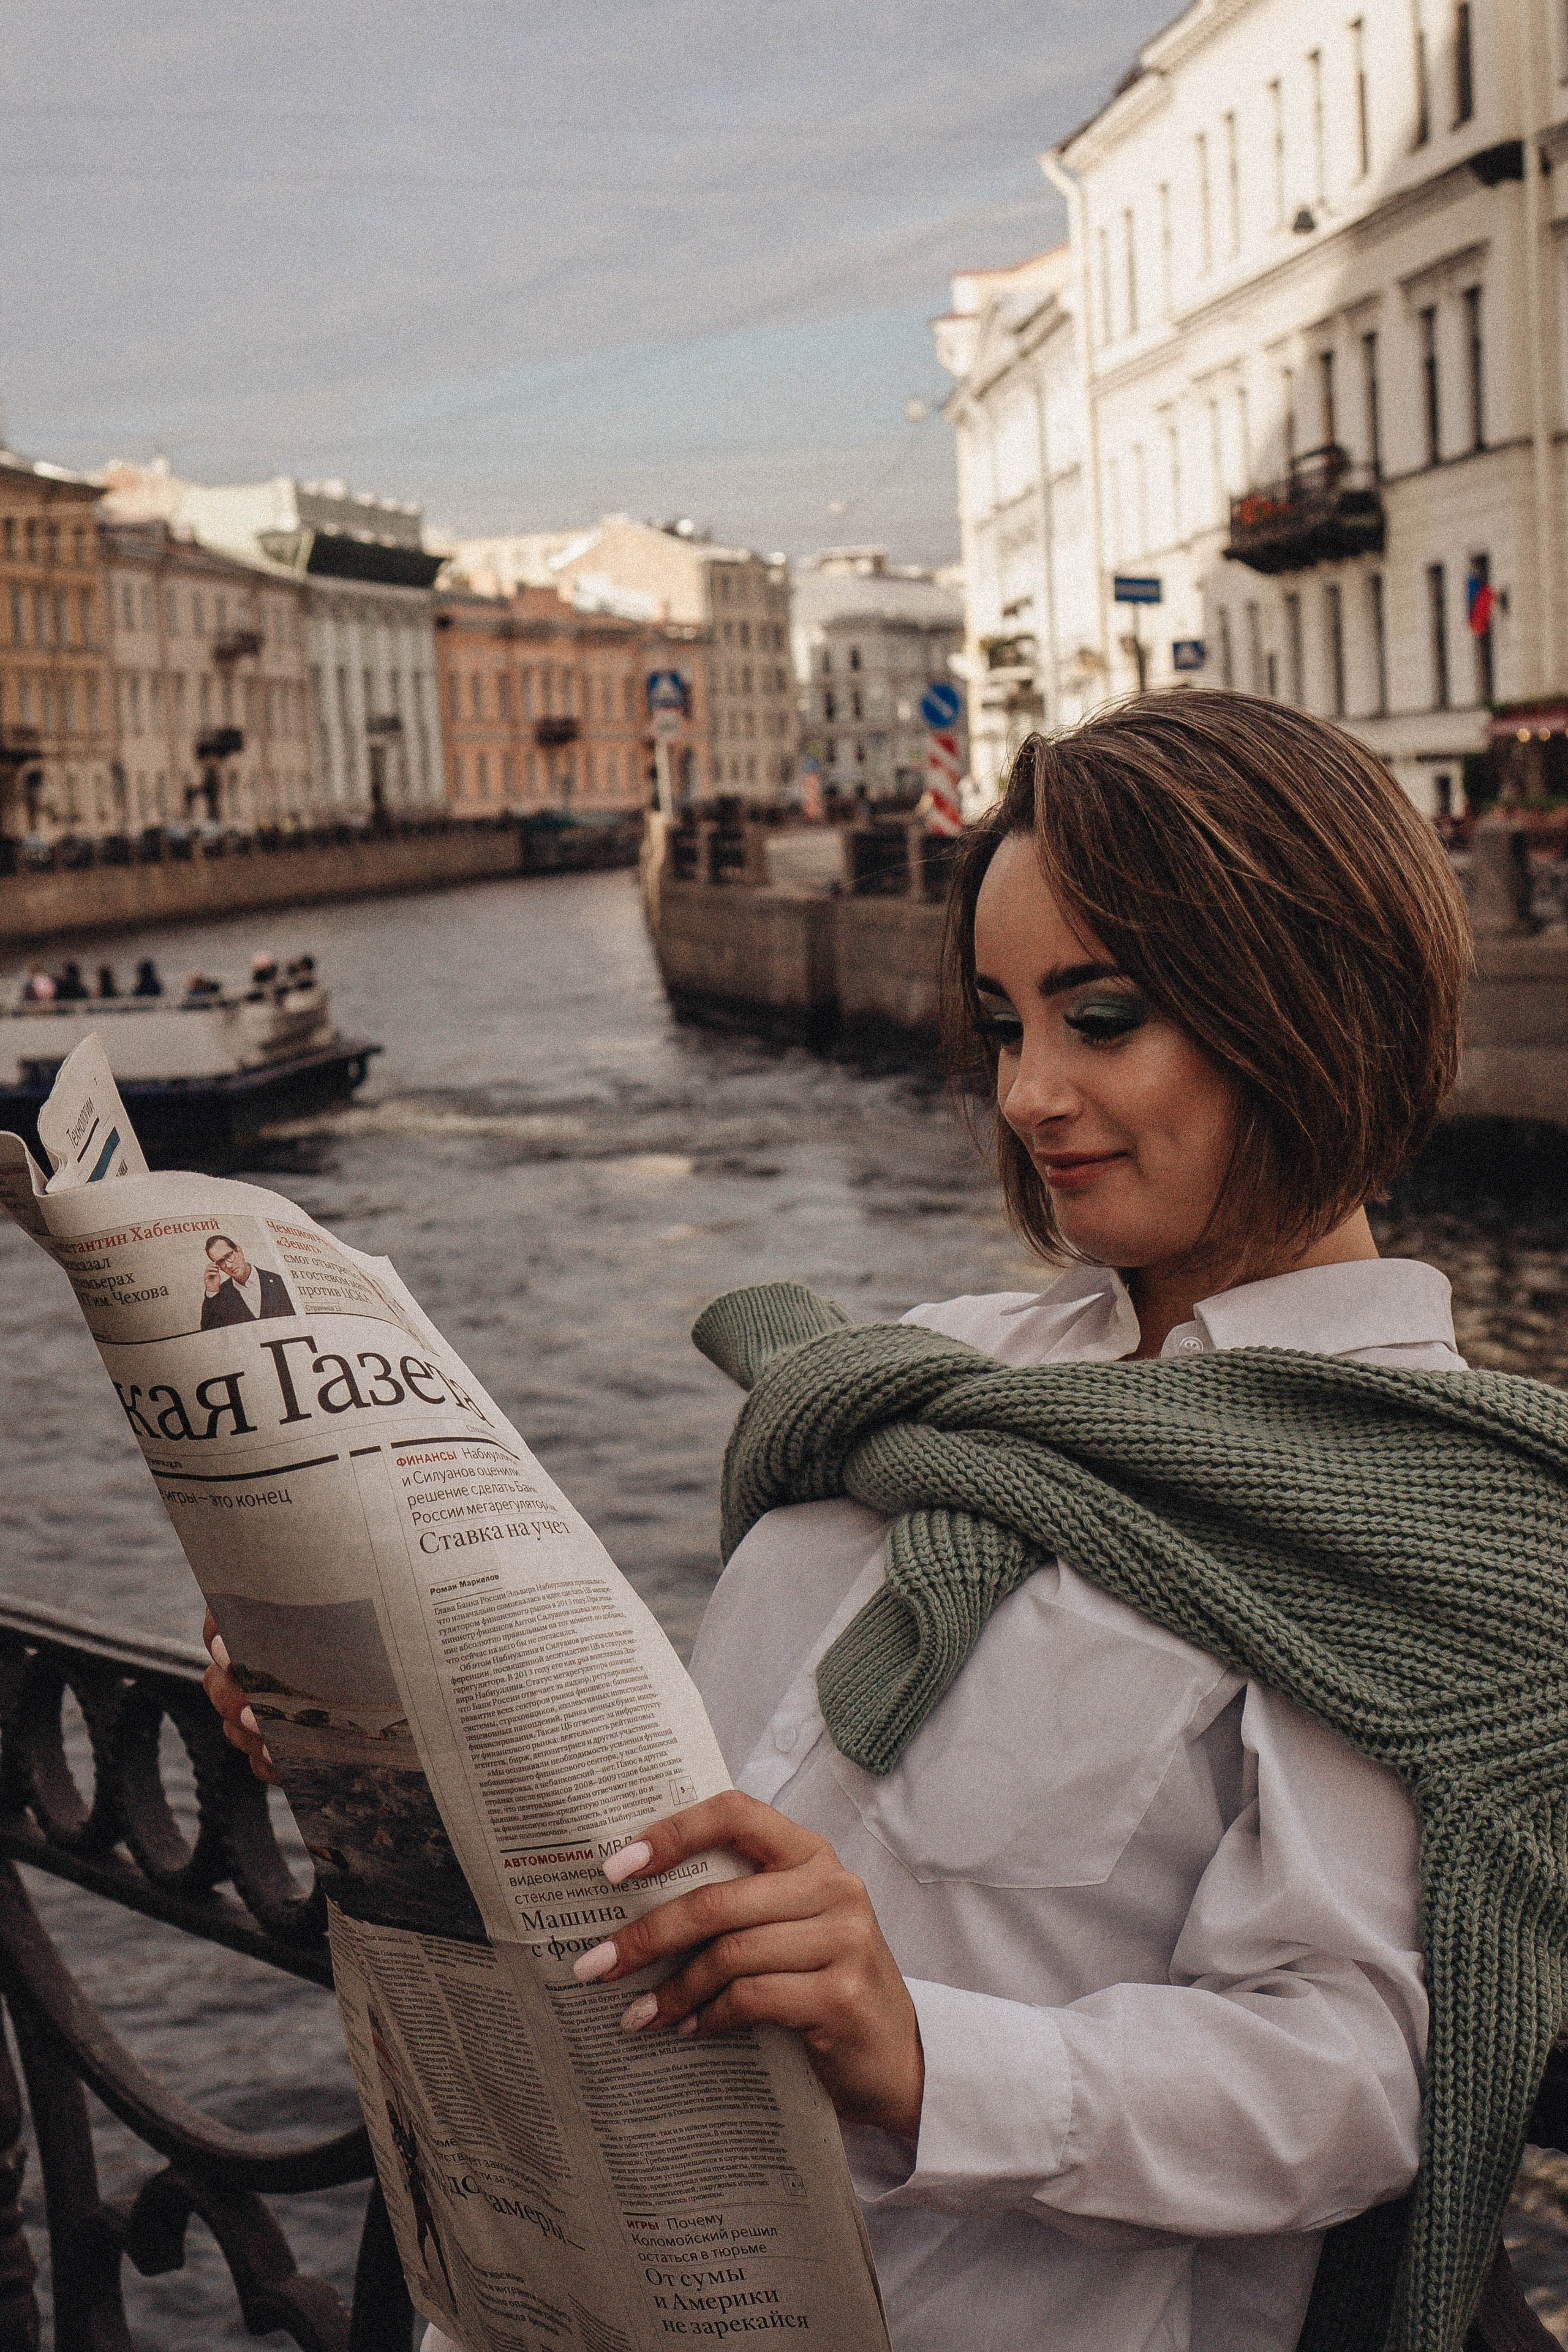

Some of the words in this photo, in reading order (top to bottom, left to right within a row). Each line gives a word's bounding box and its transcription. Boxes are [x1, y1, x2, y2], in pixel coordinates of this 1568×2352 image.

[66, 1096, 94, 1150] Технологии
[130, 1218, 221, 1242] Хабенский
[276, 1236, 322, 1253] «Зенит»
[284, 1255, 310, 1265] смог
[300, 1271, 350, 1286] гостевом
[113, 1286, 169, 1305] Чехова
[298, 1286, 341, 1298] против
[260, 1336, 495, 1428] Газета
[396, 1450, 457, 1467] ФИНАНСЫ
[402, 1477, 410, 1487] и
[413, 1468, 474, 1485] Силуанов
[477, 1467, 521, 1478] оценили
[167, 1491, 197, 1506] игры
[209, 1495, 233, 1508] это
[236, 1489, 292, 1507] конец
[407, 1487, 468, 1509] решение
[471, 1483, 515, 1496] сделать
[412, 1507, 464, 1526] России
[420, 1524, 503, 1554] Ставка
[507, 1521, 530, 1537] на
[530, 1521, 571, 1540] учет
[430, 1583, 458, 1596] Роман
[459, 1574, 499, 1589] Маркелов
[434, 1605, 456, 1615] Глава
[456, 1599, 479, 1610] Банка
[480, 1593, 507, 1604] России
[506, 1586, 535, 1597] Эльвира
[436, 1616, 451, 1625] что
[451, 1606, 496, 1621] изначально
[496, 1596, 541, 1610] сомневалась
[438, 1620, 480, 1635] гулятором
[481, 1608, 529, 1626] финансового
[529, 1603, 551, 1614] рынка
[556, 1597, 572, 1607] 2013
[441, 1632, 476, 1645] министр
[475, 1623, 513, 1637] финансов
[513, 1616, 537, 1626] Антон
[537, 1610, 570, 1621] Силуанов
[460, 1649, 487, 1660] сейчас
[492, 1654, 544, 1673] посвященной
[544, 1646, 590, 1661] десятилетию
[513, 1668, 533, 1679] 2013
[460, 1711, 496, 1725] развитие
[496, 1706, 514, 1715] всех
[514, 1697, 551, 1710] секторов
[551, 1691, 575, 1703] рынка
[465, 1727, 513, 1741] пенсионных
[564, 1709, 587, 1721] рынка
[587, 1702, 616, 1714] ценных
[535, 1726, 561, 1736] Также
[560, 1721, 572, 1731] ЦБ
[573, 1714, 605, 1727] отвечает
[481, 1744, 530, 1760] финансового
[559, 1724, 610, 1742] деятельность
[537, 1785, 573, 1799] кризисов
[617, 1769, 638, 1779] годов
[517, 1798, 566, 1812] центральные
[566, 1792, 591, 1802] банки
[592, 1782, 628, 1796] отвечают
[503, 1849, 594, 1869] АВТОМОБИЛИ
[515, 1890, 563, 1904] стекле
[566, 1884, 608, 1899] никто
[612, 1882, 630, 1893] не
[631, 1861, 708, 1888] запрещал
[519, 1904, 628, 1931] Машина
[531, 1944, 542, 1958] с
[658, 2046, 678, 2054] МВД
[656, 2082, 687, 2091] боковое
[622, 2113, 667, 2125] утверждают
[670, 2158, 718, 2169] запрещается
[626, 2219, 660, 2230] ИГРЫ
[667, 2213, 723, 2230] Почему
[631, 2228, 728, 2247] Коломойский
[731, 2226, 778, 2242] решил
[639, 2251, 698, 2263] остаться
[701, 2252, 709, 2260] в
[711, 2243, 767, 2258] тюрьме
[645, 2268, 675, 2286] От
[680, 2267, 746, 2291] сумы
[654, 2296, 668, 2310] и
[673, 2290, 780, 2314] Америки
[662, 2318, 687, 2334] не
[690, 2310, 809, 2339] зарекайся
